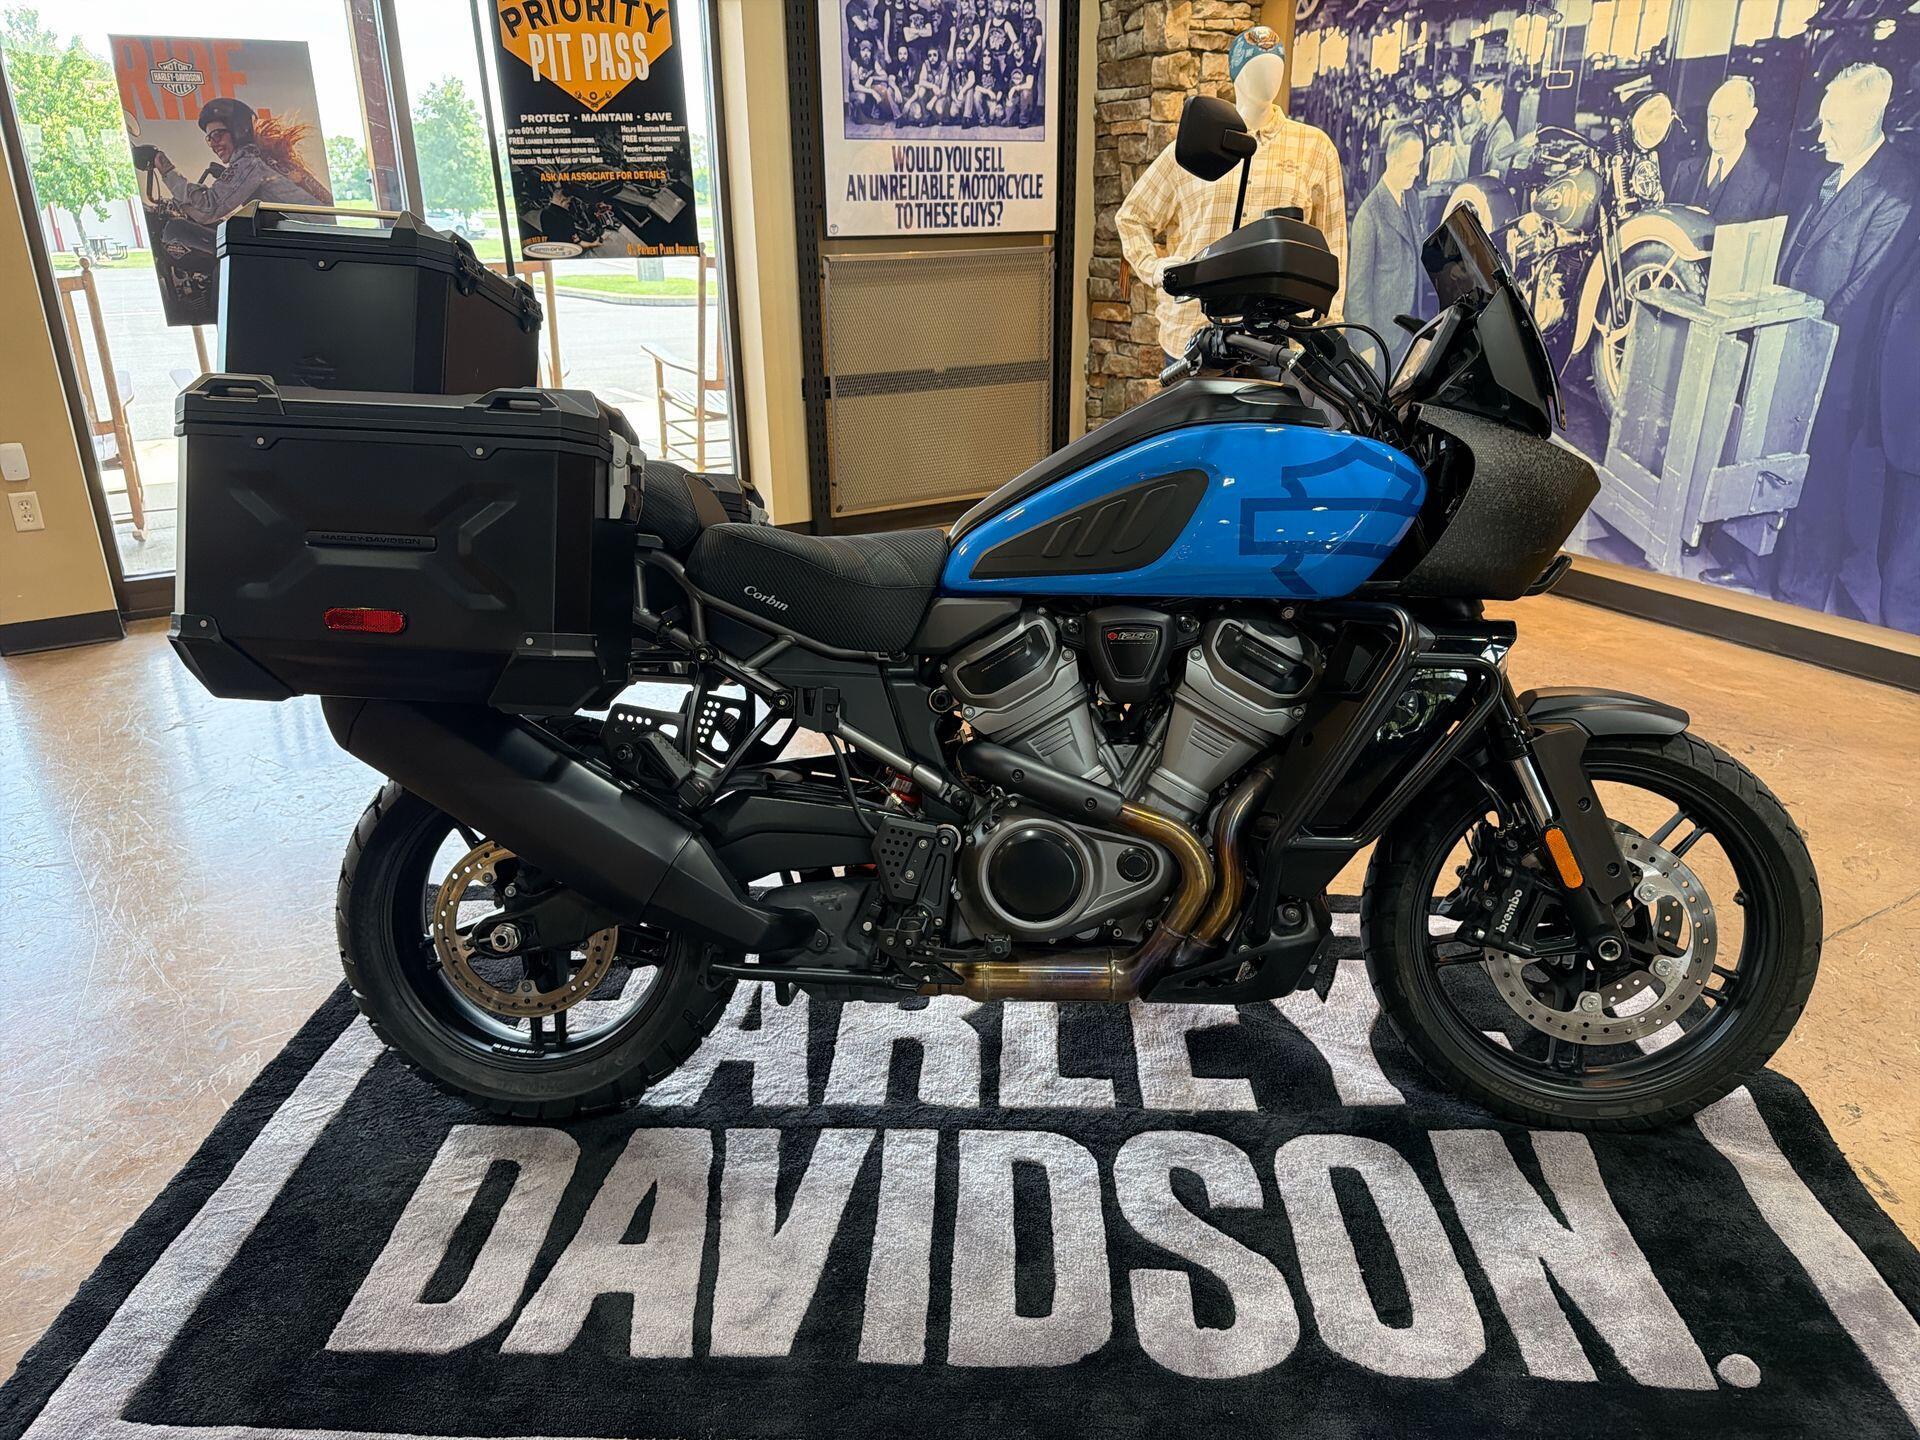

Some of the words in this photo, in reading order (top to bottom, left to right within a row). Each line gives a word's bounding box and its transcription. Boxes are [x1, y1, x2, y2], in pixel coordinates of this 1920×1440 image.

[500, 0, 667, 38] PRIORITY
[161, 61, 190, 70] MOTOR
[528, 33, 572, 82] PIT
[581, 31, 650, 81] PASS
[153, 72, 202, 82] HARLEY-DAVIDSON
[520, 114, 570, 123] PROTECT
[581, 113, 633, 122] MAINTAIN
[644, 112, 672, 121] SAVE
[521, 126, 535, 135] 60%
[535, 126, 548, 134] OFF
[622, 135, 638, 143] FREE
[508, 137, 525, 145] FREE
[892, 145, 943, 173] WOULD
[944, 146, 971, 172] YOU
[974, 146, 1005, 172] SELL
[540, 172, 557, 182] ASK
[559, 172, 569, 181] AN
[571, 171, 615, 181] ASSOCIATE
[616, 171, 632, 180] FOR
[633, 170, 667, 180] DETAILS
[846, 174, 866, 201] AN
[869, 174, 955, 201] UNRELIABLE
[958, 174, 1043, 200] MOTORCYCLE
[895, 202, 913, 229] TO
[915, 202, 958, 229] THESE
[961, 201, 1004, 227] GUYS?
[744, 585, 788, 611] Corbin
[1495, 889, 1523, 933] brembo
